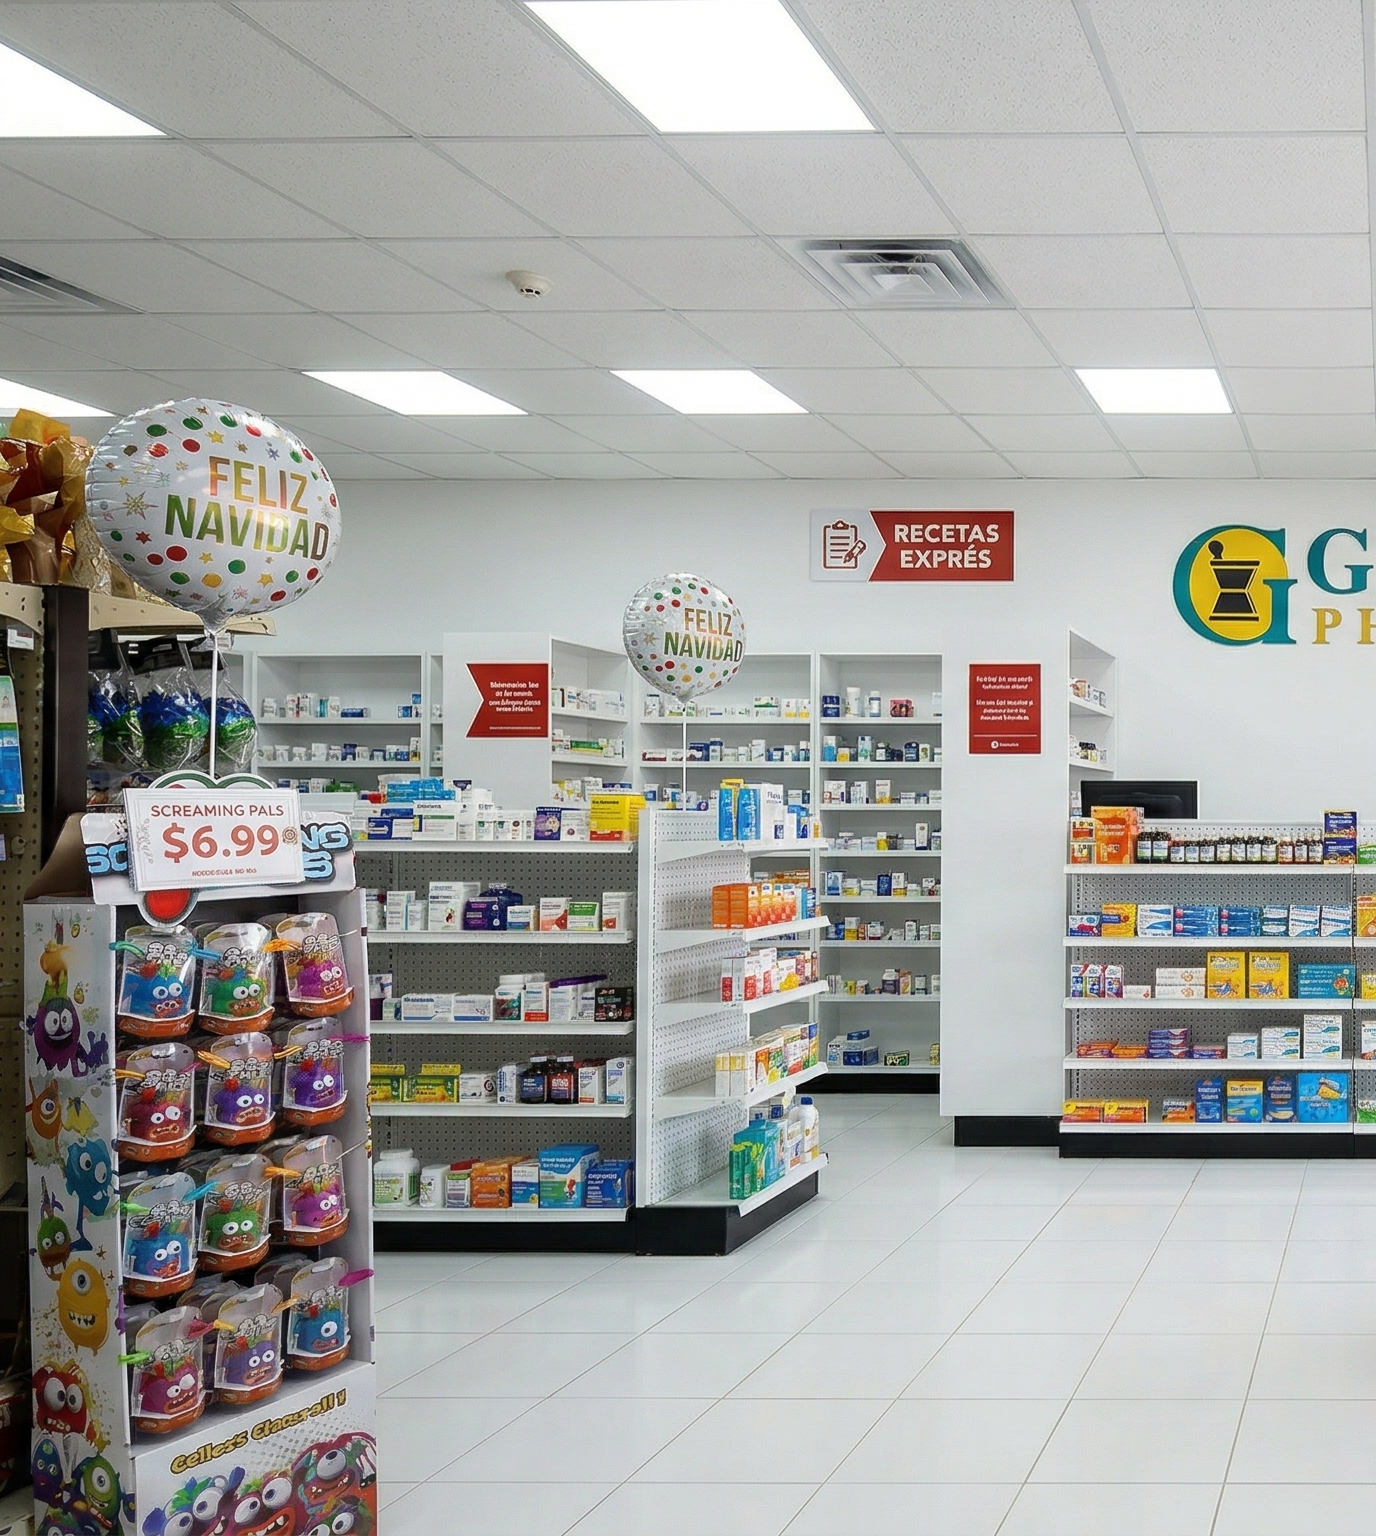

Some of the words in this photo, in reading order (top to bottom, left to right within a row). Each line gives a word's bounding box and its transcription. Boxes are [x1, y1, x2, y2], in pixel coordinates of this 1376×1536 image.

[208, 455, 309, 514] FELIZ
[165, 494, 329, 561] NAVIDAD
[894, 524, 1000, 543] RECETAS
[900, 545, 992, 569] EXPRÉS
[684, 607, 733, 637] FELIZ
[664, 632, 743, 662] NAVIDAD
[151, 804, 245, 817] SCREAMING
[249, 804, 284, 816] PALS
[162, 822, 280, 863] $6.99
